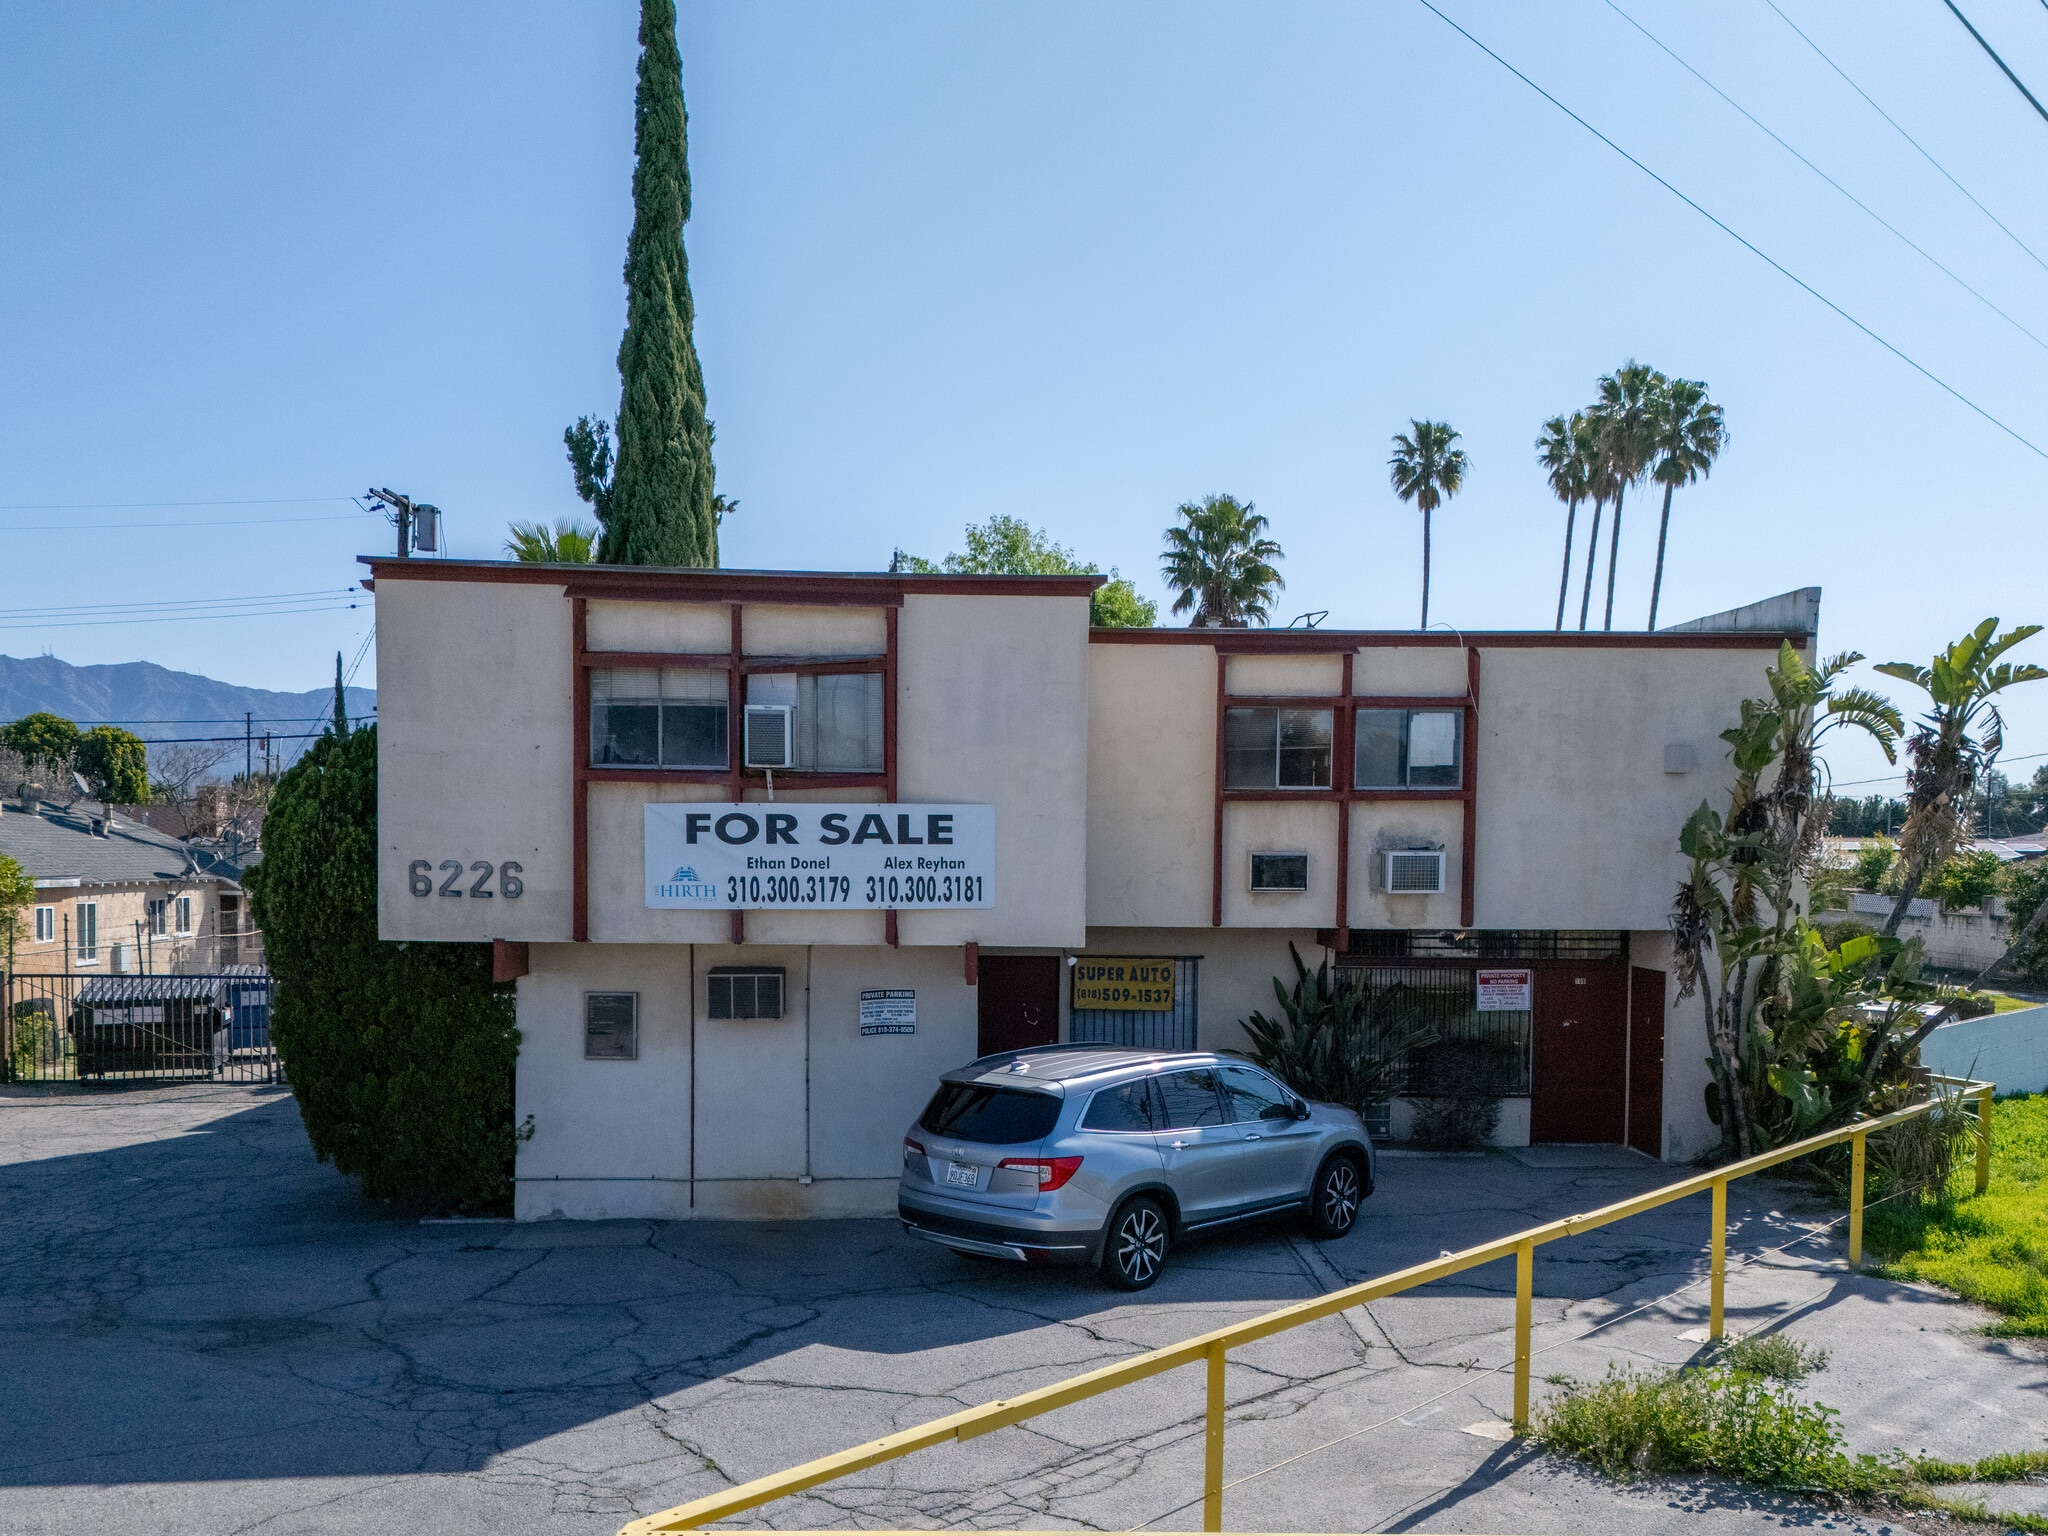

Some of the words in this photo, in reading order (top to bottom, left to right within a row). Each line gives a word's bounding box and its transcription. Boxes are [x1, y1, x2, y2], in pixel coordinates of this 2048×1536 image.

[686, 813, 800, 845] FOR
[818, 813, 954, 846] SALE
[747, 856, 786, 870] Ethan
[790, 856, 830, 870] Donel
[884, 857, 913, 870] Alex
[917, 857, 966, 873] Reyhan
[408, 860, 523, 899] 6226
[661, 885, 717, 898] HIRTH
[727, 876, 851, 903] 310.300.3179
[866, 876, 983, 903] 310.300.3181
[1077, 966, 1125, 982] SUPER
[1129, 967, 1172, 982] AUTO
[861, 991, 885, 1000] PRIVATE
[861, 1027, 877, 1035] POLICE
